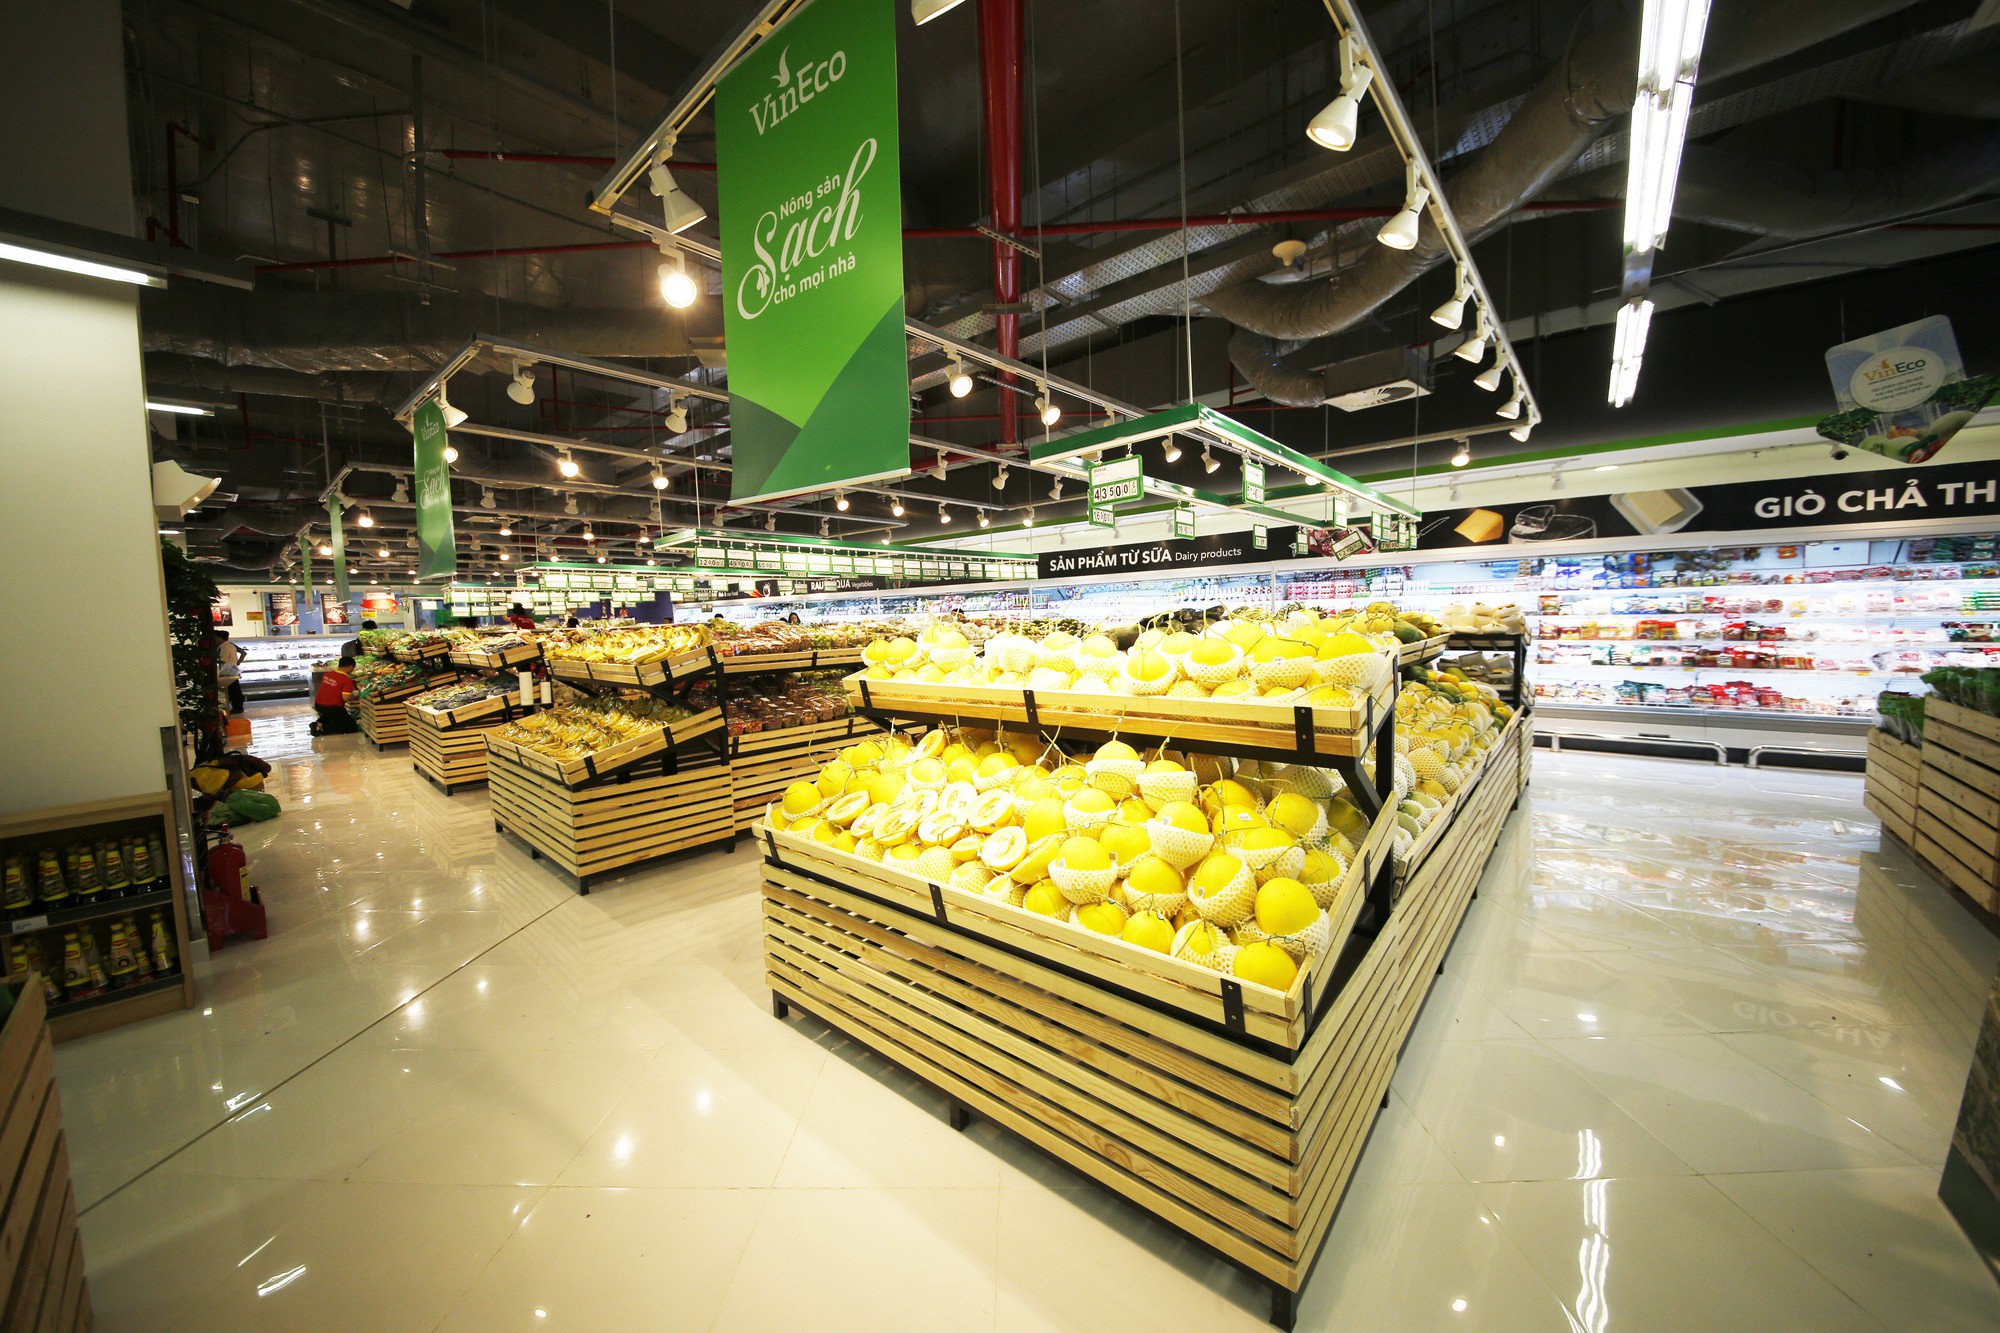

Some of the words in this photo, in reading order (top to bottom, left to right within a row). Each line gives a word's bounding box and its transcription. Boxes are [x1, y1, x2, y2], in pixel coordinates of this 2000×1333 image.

[749, 50, 847, 136] VinEco
[779, 191, 813, 220] Nông
[816, 174, 840, 200] sản
[737, 138, 878, 320] Sạch
[774, 281, 796, 304] cho
[800, 266, 824, 293] mọi
[829, 252, 856, 279] nhà
[1862, 359, 1926, 381] VinEco
[1094, 484, 1129, 500] 43500
[1754, 489, 1826, 518] GIÒ
[1837, 479, 1928, 513] CHẢ
[1050, 555, 1075, 572] SẢN
[1078, 551, 1117, 569] PHẨM
[1120, 549, 1140, 566] TỪ
[1142, 546, 1172, 564] SỮA
[1175, 551, 1198, 563] Dairy
[1200, 548, 1242, 560] products
[851, 580, 874, 590] Vegetables
